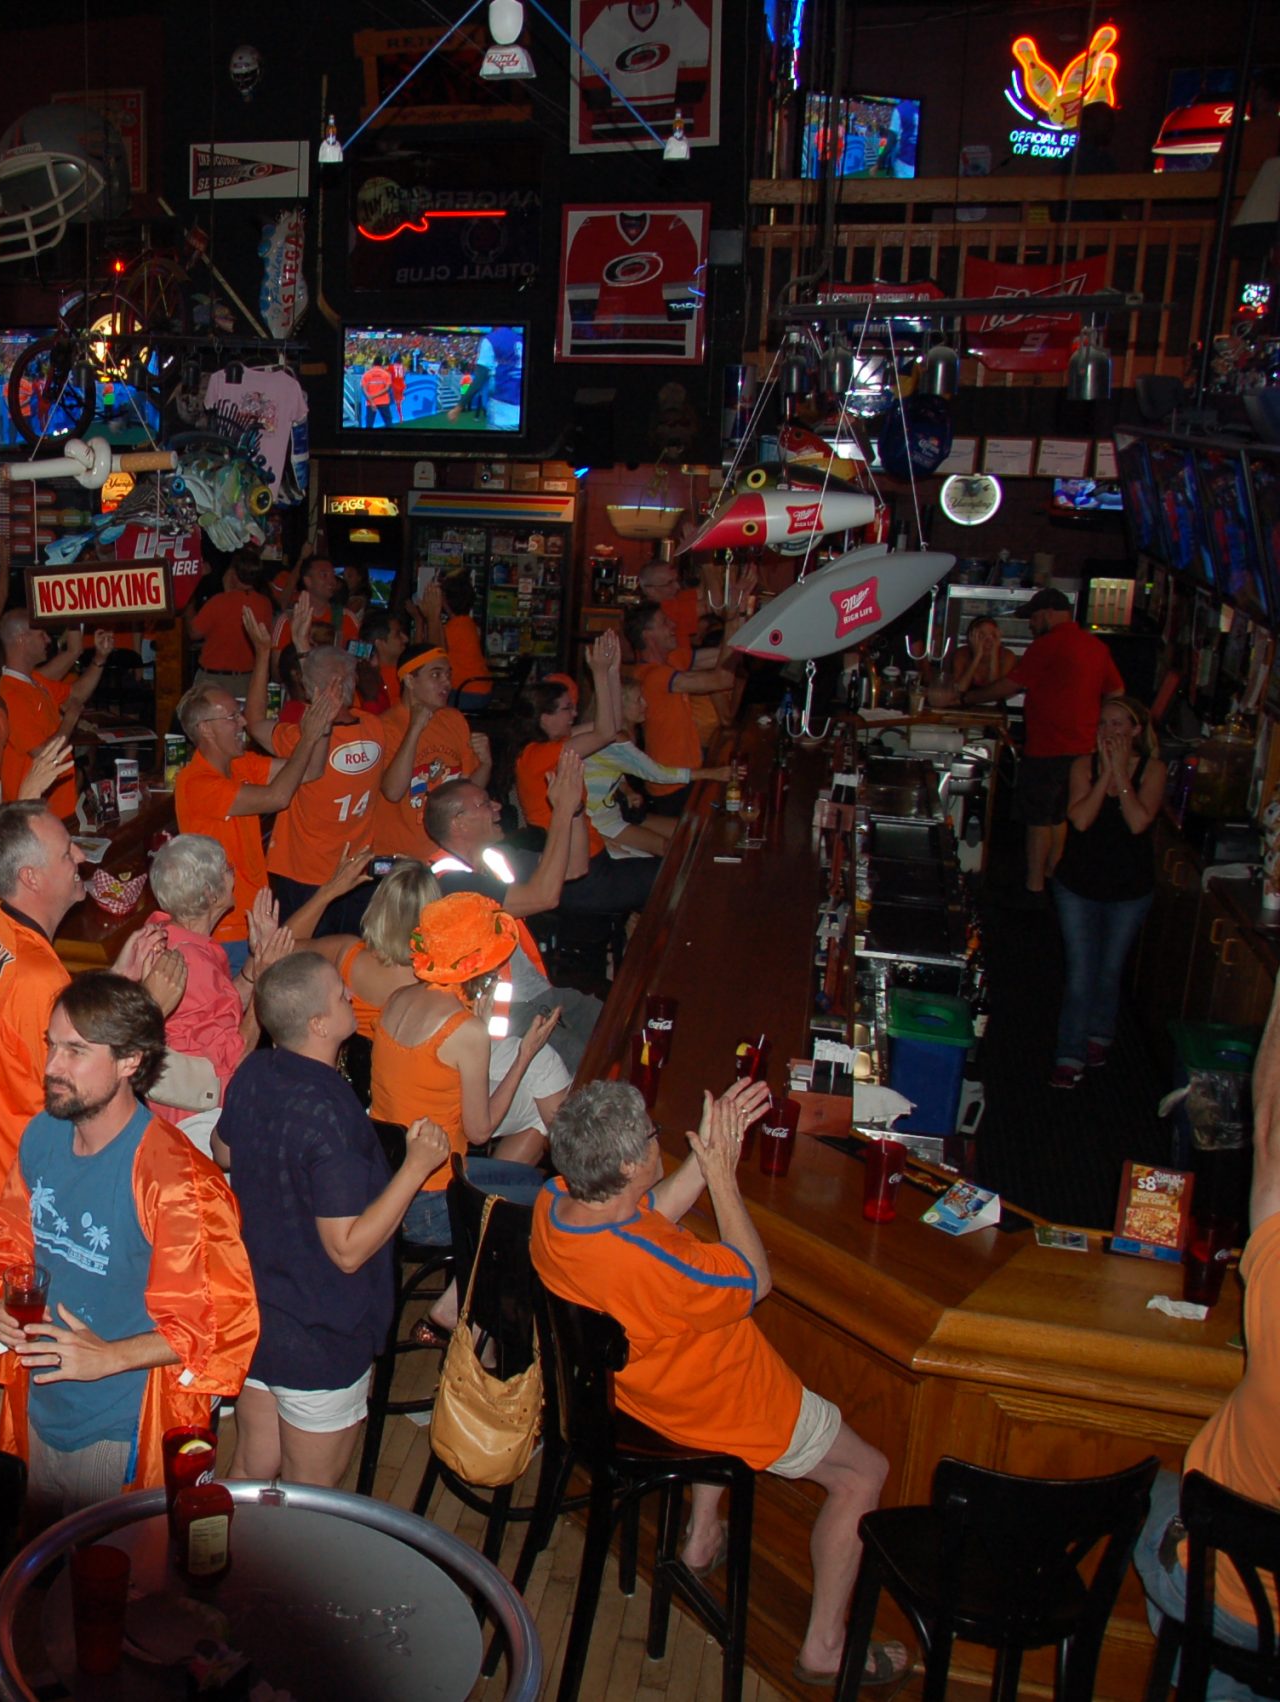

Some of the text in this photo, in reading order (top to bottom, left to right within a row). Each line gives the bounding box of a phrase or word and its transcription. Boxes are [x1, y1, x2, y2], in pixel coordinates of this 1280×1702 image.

[1009, 130, 1057, 146] OFFICIAL
[1012, 143, 1029, 156] OF
[283, 221, 302, 288] VEGAS
[330, 499, 365, 513] BAGS
[134, 532, 193, 560] UFC
[333, 790, 371, 822] 14
